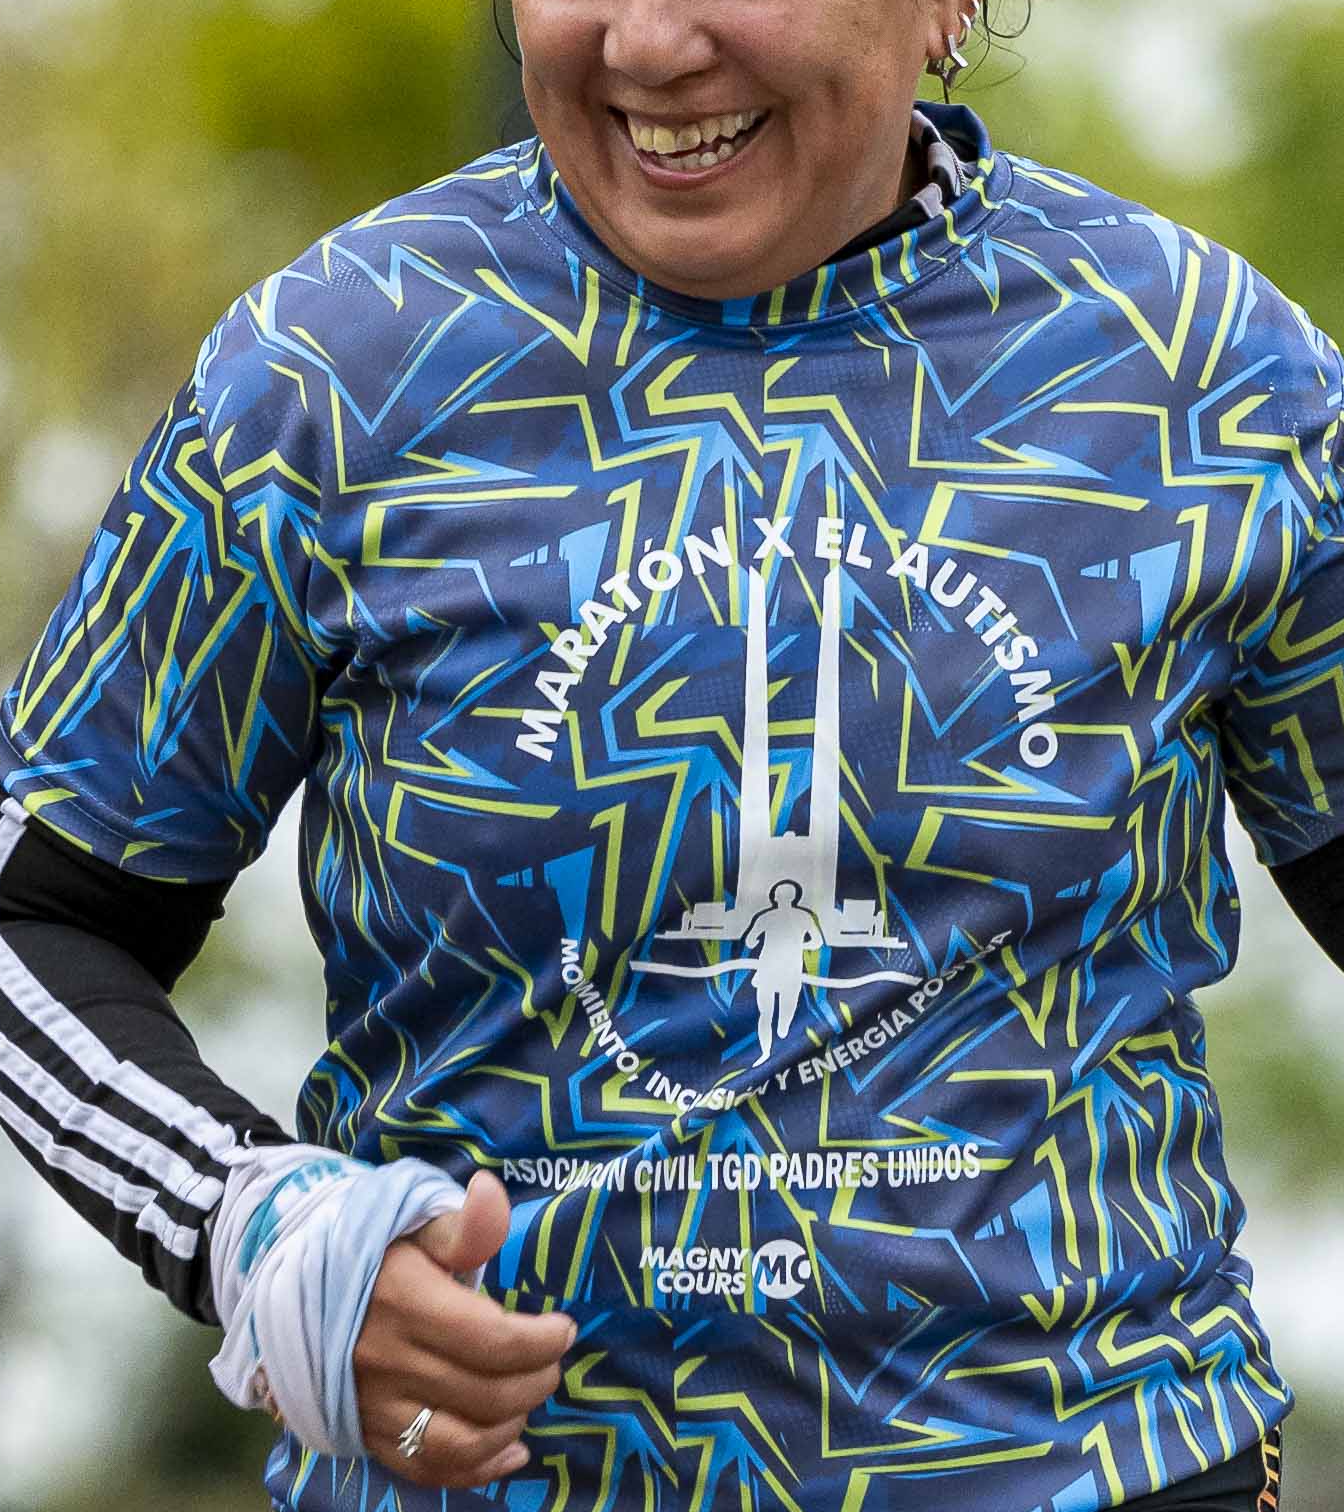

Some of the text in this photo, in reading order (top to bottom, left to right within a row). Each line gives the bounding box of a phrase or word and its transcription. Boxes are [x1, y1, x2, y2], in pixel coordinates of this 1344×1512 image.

[515, 516, 1058, 768] MARATÓN X EL AUTISMO
[775, 1068, 791, 1091] Y
[798, 1007, 916, 1085] ENERGÍA
[634, 1153, 702, 1192] CIVIL
[707, 1153, 762, 1191] TGD
[769, 1151, 879, 1190] PADRES
[887, 1142, 981, 1188] UNIDOS
[639, 1246, 748, 1270] MAGNY
[656, 1271, 748, 1296] COURS
